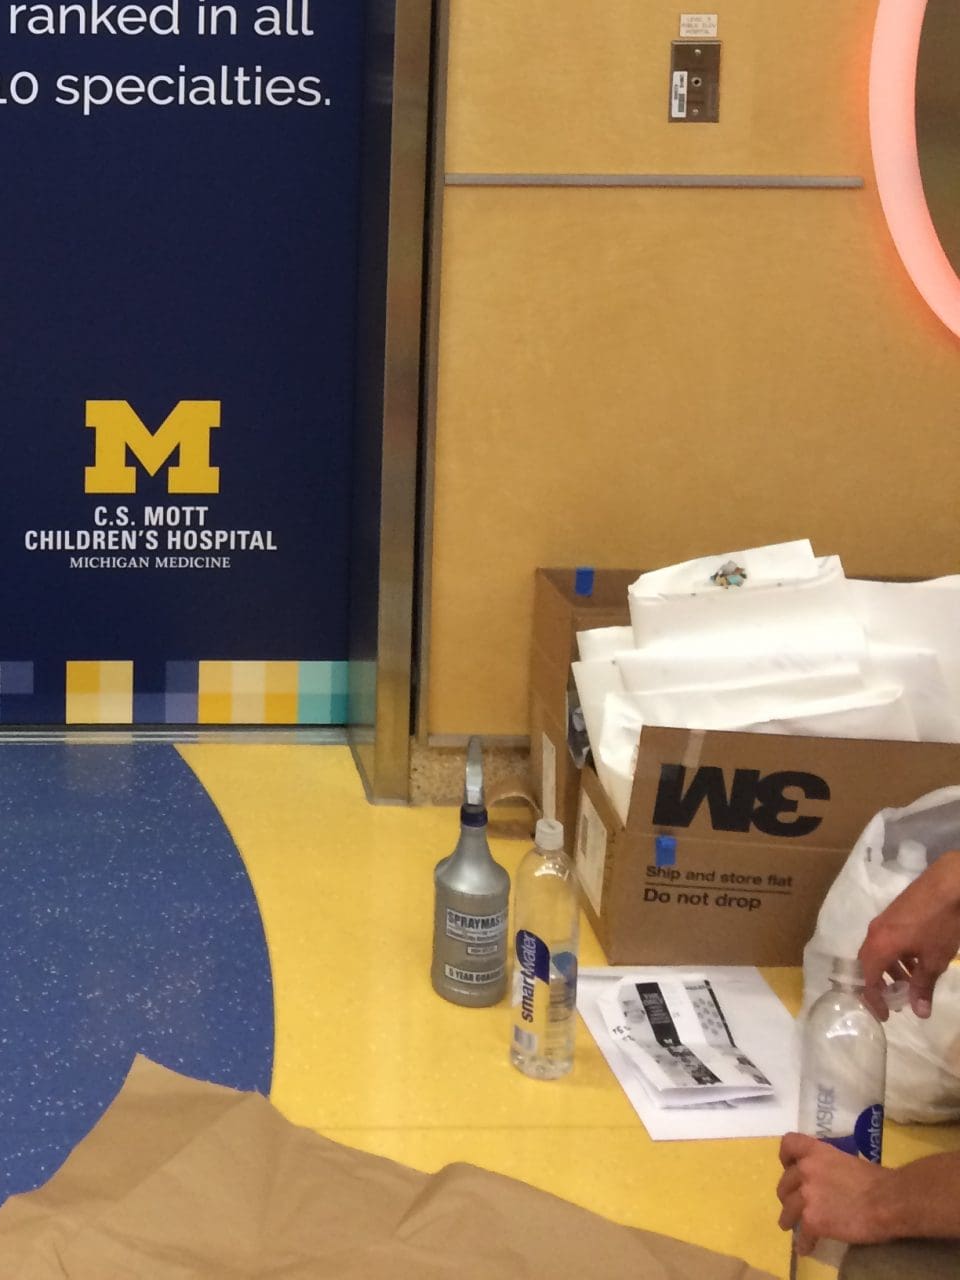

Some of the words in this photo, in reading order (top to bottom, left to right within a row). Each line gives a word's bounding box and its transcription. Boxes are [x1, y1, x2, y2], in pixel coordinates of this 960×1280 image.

[55, 65, 332, 116] specialties.
[84, 399, 221, 494] M
[94, 505, 136, 527] C.S.
[144, 505, 209, 527] MOTT
[24, 530, 160, 551] CHILDREN'S
[167, 530, 278, 551] HOSPITAL
[69, 557, 150, 569] MICHIGAN
[155, 557, 231, 569] MEDICINE
[646, 865, 681, 883] Ship
[686, 869, 716, 882] and
[720, 872, 763, 886] store
[768, 874, 793, 887] flat
[643, 887, 671, 903] Do
[677, 891, 710, 906] not
[715, 893, 762, 911] drop
